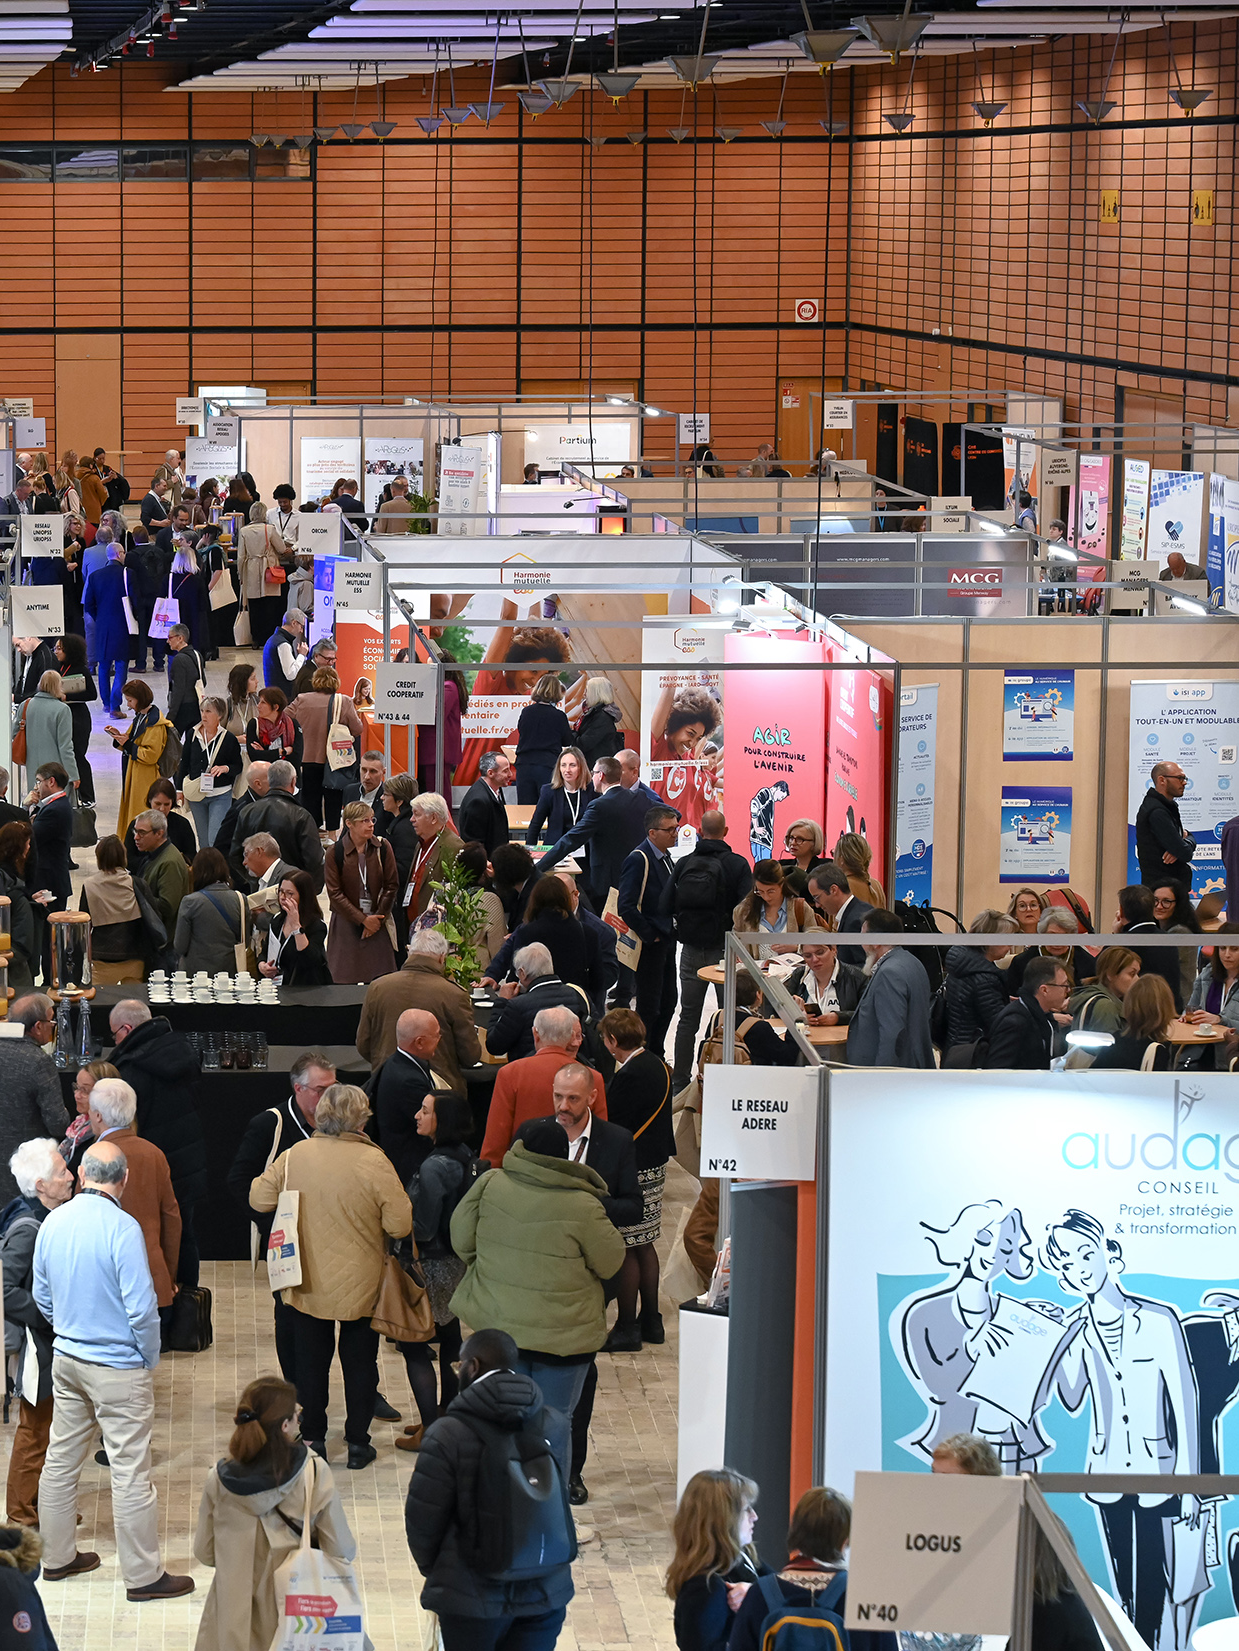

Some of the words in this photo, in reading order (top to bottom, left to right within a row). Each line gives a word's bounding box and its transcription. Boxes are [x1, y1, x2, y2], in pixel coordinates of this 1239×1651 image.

[559, 434, 596, 444] Partium
[513, 571, 551, 579] Harmonie
[950, 572, 1001, 584] MCG
[363, 646, 401, 656] ÉCONMIE
[395, 681, 416, 689] CREDIT
[386, 690, 424, 699] COOPERATIF
[1191, 690, 1206, 700] app
[468, 699, 494, 708] édiés
[911, 715, 929, 723] SERVICE
[929, 713, 937, 721] DE
[1167, 707, 1217, 716] APPLICATION
[753, 723, 792, 747] AGIR
[744, 747, 763, 757] POUR
[763, 749, 806, 762] CONSTRUIRE
[754, 760, 794, 773] L'AVENIR
[731, 1099, 743, 1112] LE
[746, 1099, 789, 1113] RESEAU
[741, 1117, 777, 1131] ADERE
[707, 1158, 737, 1172] N°42
[1137, 1181, 1219, 1194] CONSEIL
[1120, 1204, 1165, 1219] Projet,
[1169, 1204, 1234, 1219] stratégie
[1115, 1223, 1125, 1234] &
[1129, 1222, 1237, 1235] transformation
[906, 1533, 962, 1553] LOGUS
[857, 1603, 899, 1622] N°40
